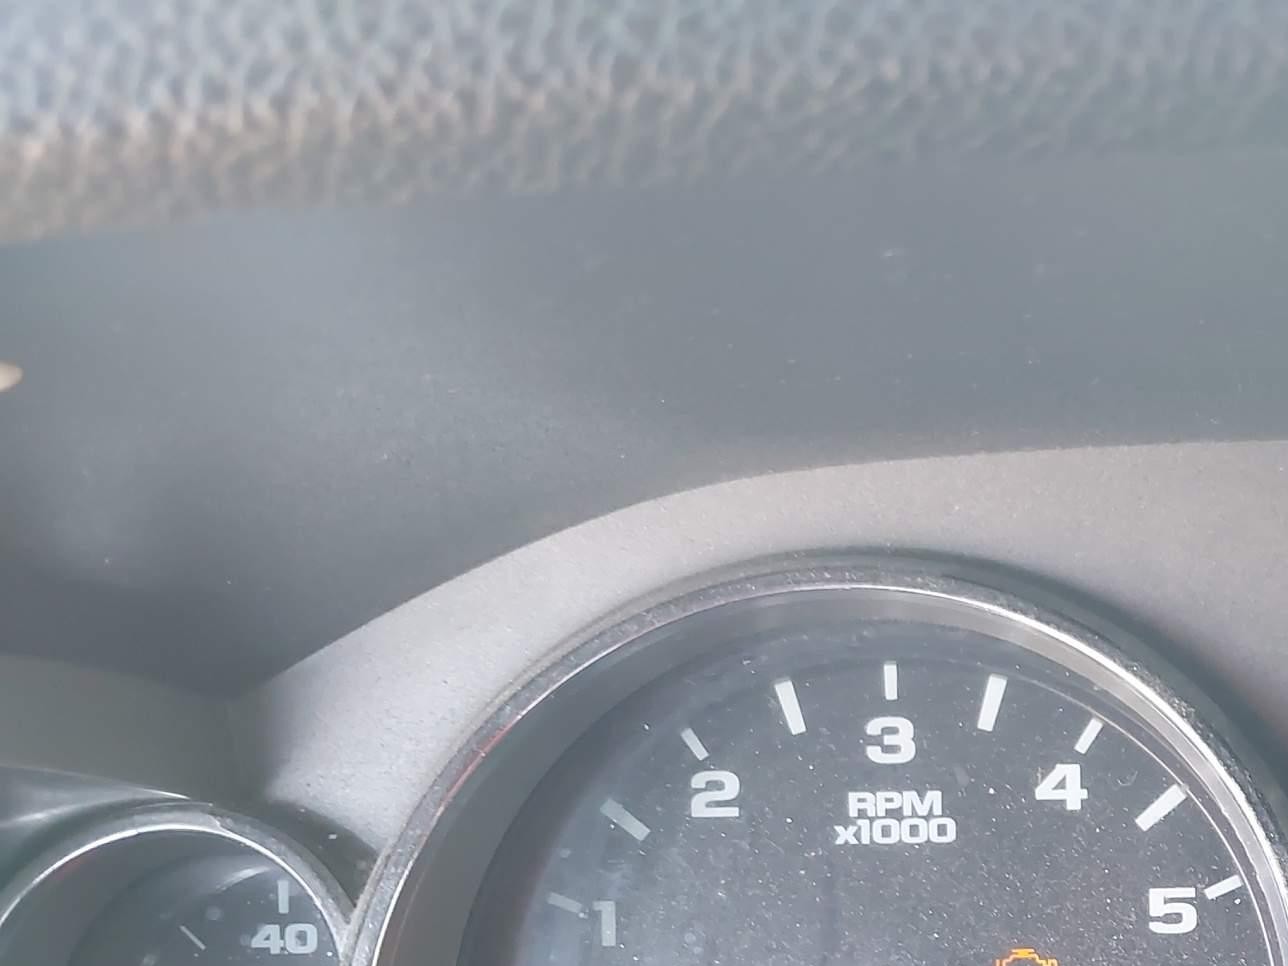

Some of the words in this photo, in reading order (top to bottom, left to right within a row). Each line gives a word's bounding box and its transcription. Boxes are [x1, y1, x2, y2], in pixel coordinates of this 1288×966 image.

[866, 716, 916, 764] 3
[690, 769, 741, 818] 2
[847, 791, 942, 818] RPM
[1034, 763, 1089, 811] 4
[834, 818, 957, 845] x1000
[592, 900, 616, 946] 1
[1148, 887, 1198, 934] 5
[250, 923, 318, 954] 40
